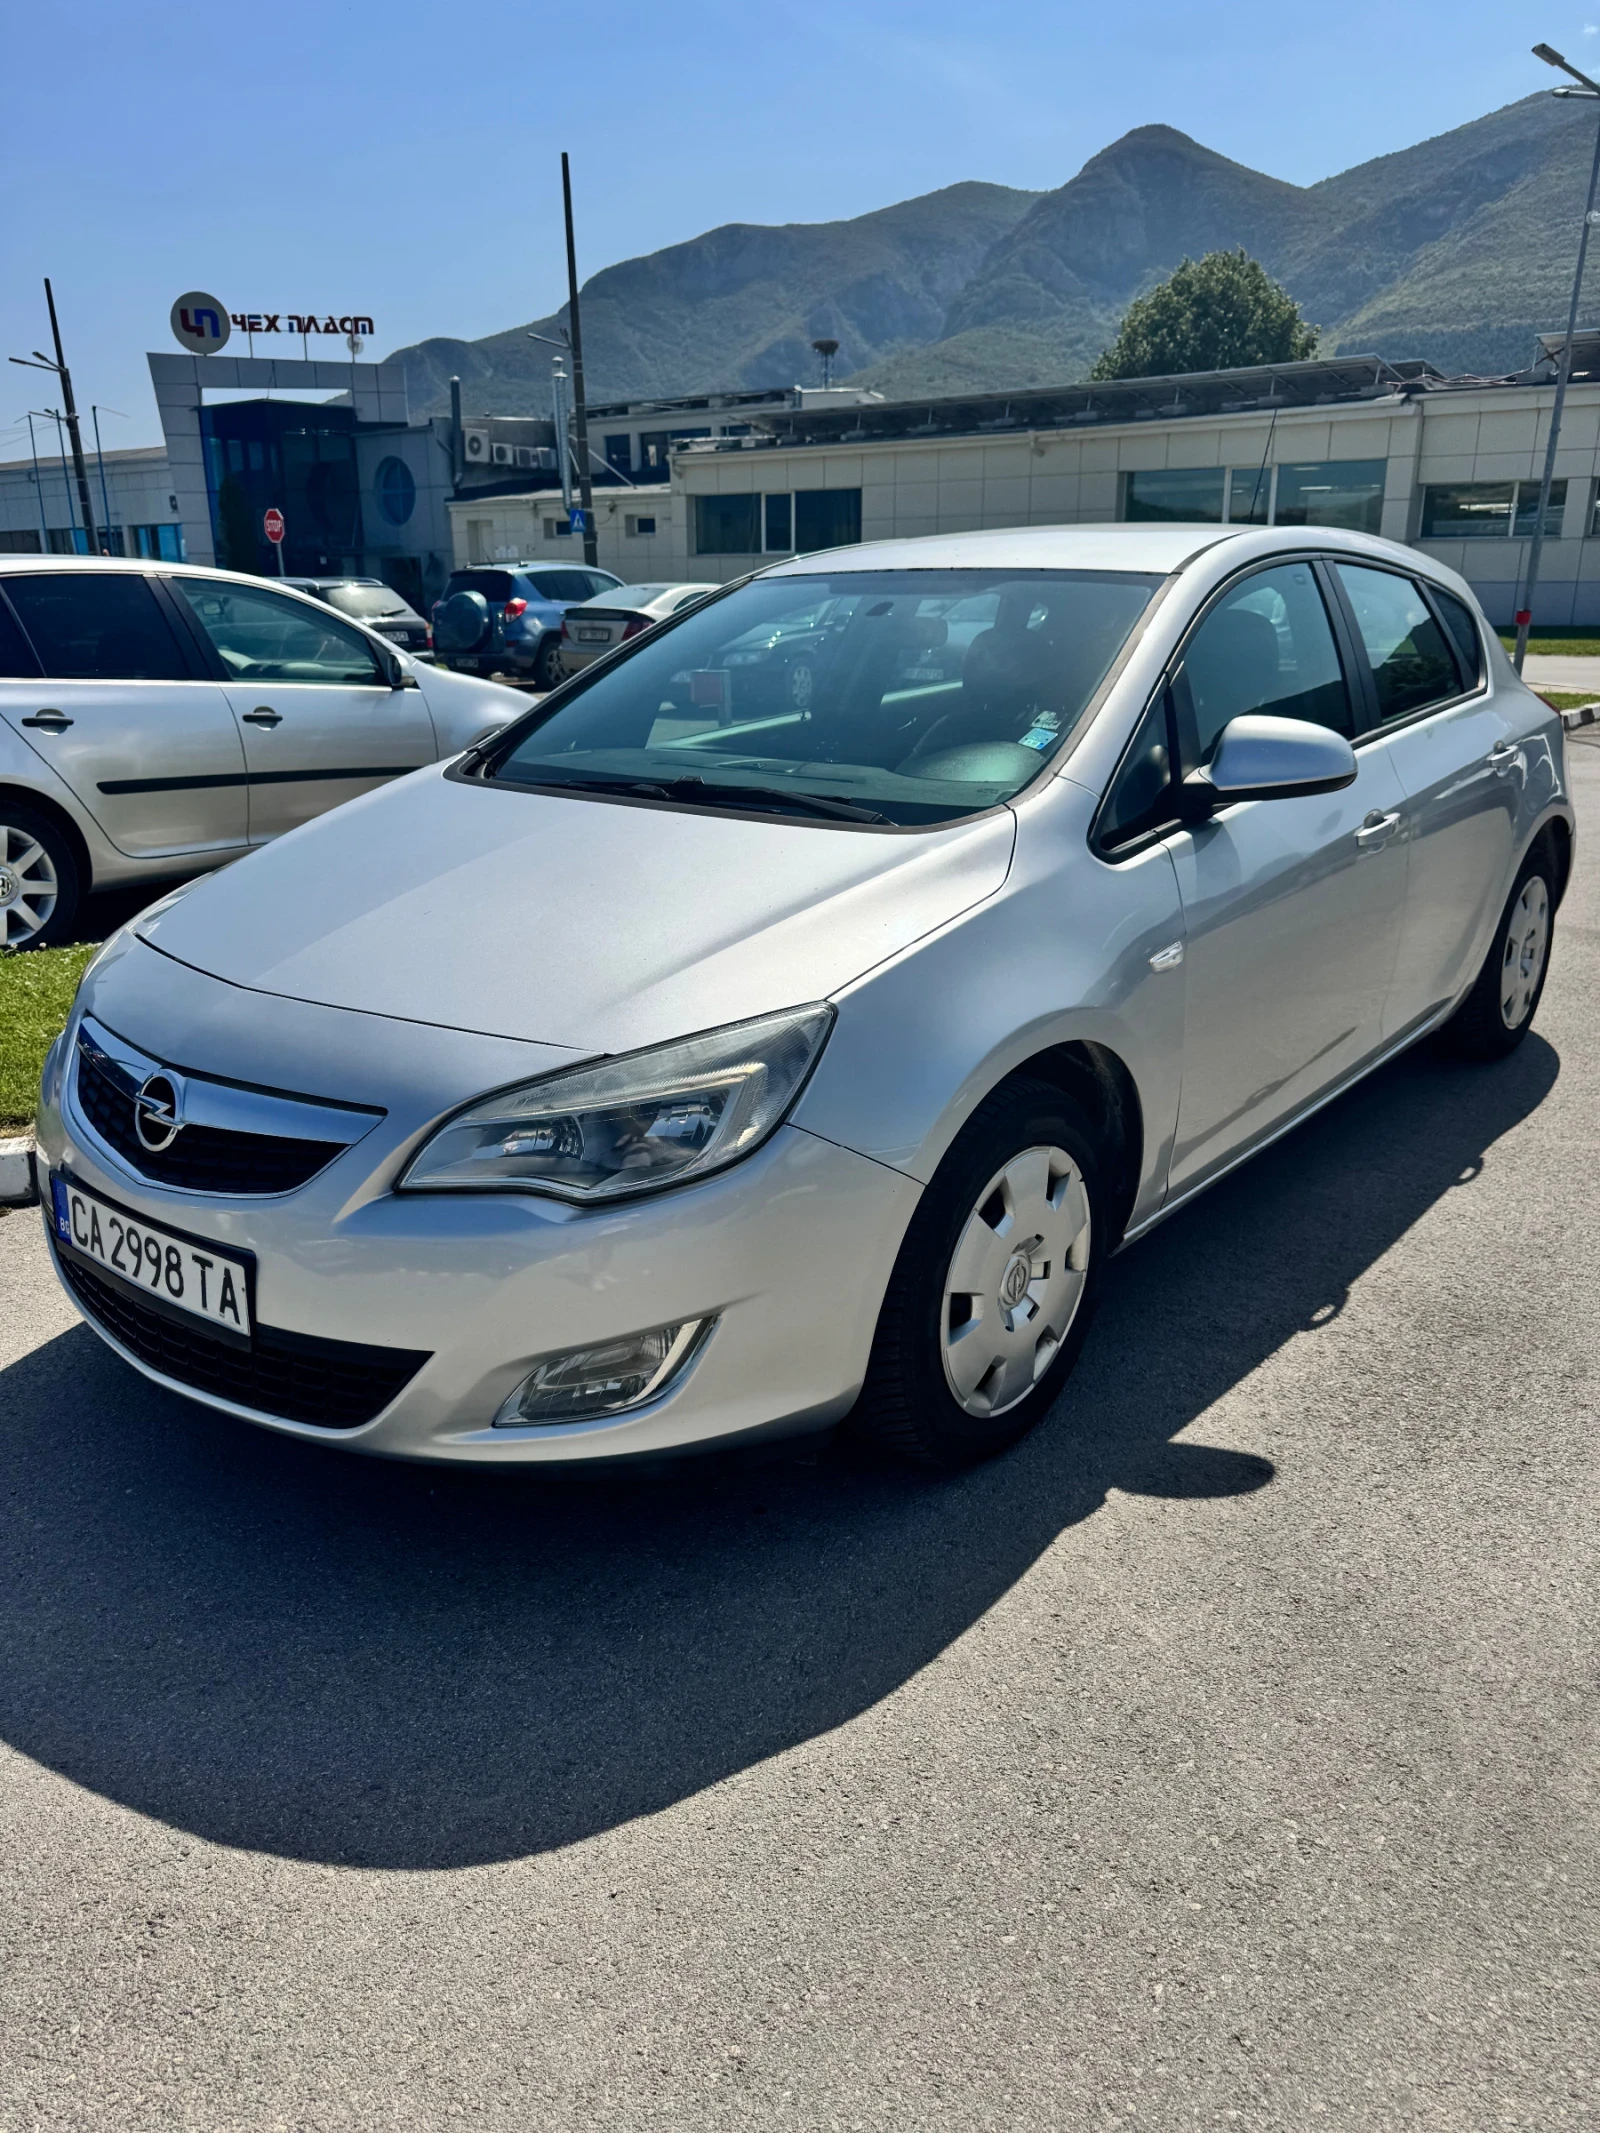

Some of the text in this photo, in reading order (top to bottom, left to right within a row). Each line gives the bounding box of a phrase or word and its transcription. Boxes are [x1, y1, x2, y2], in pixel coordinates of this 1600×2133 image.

[231, 314, 374, 335] ЧЕХ ПЛАСТ
[265, 519, 283, 532] STOP
[60, 1217, 70, 1235] BG
[71, 1195, 240, 1325] CA 2998 TA
